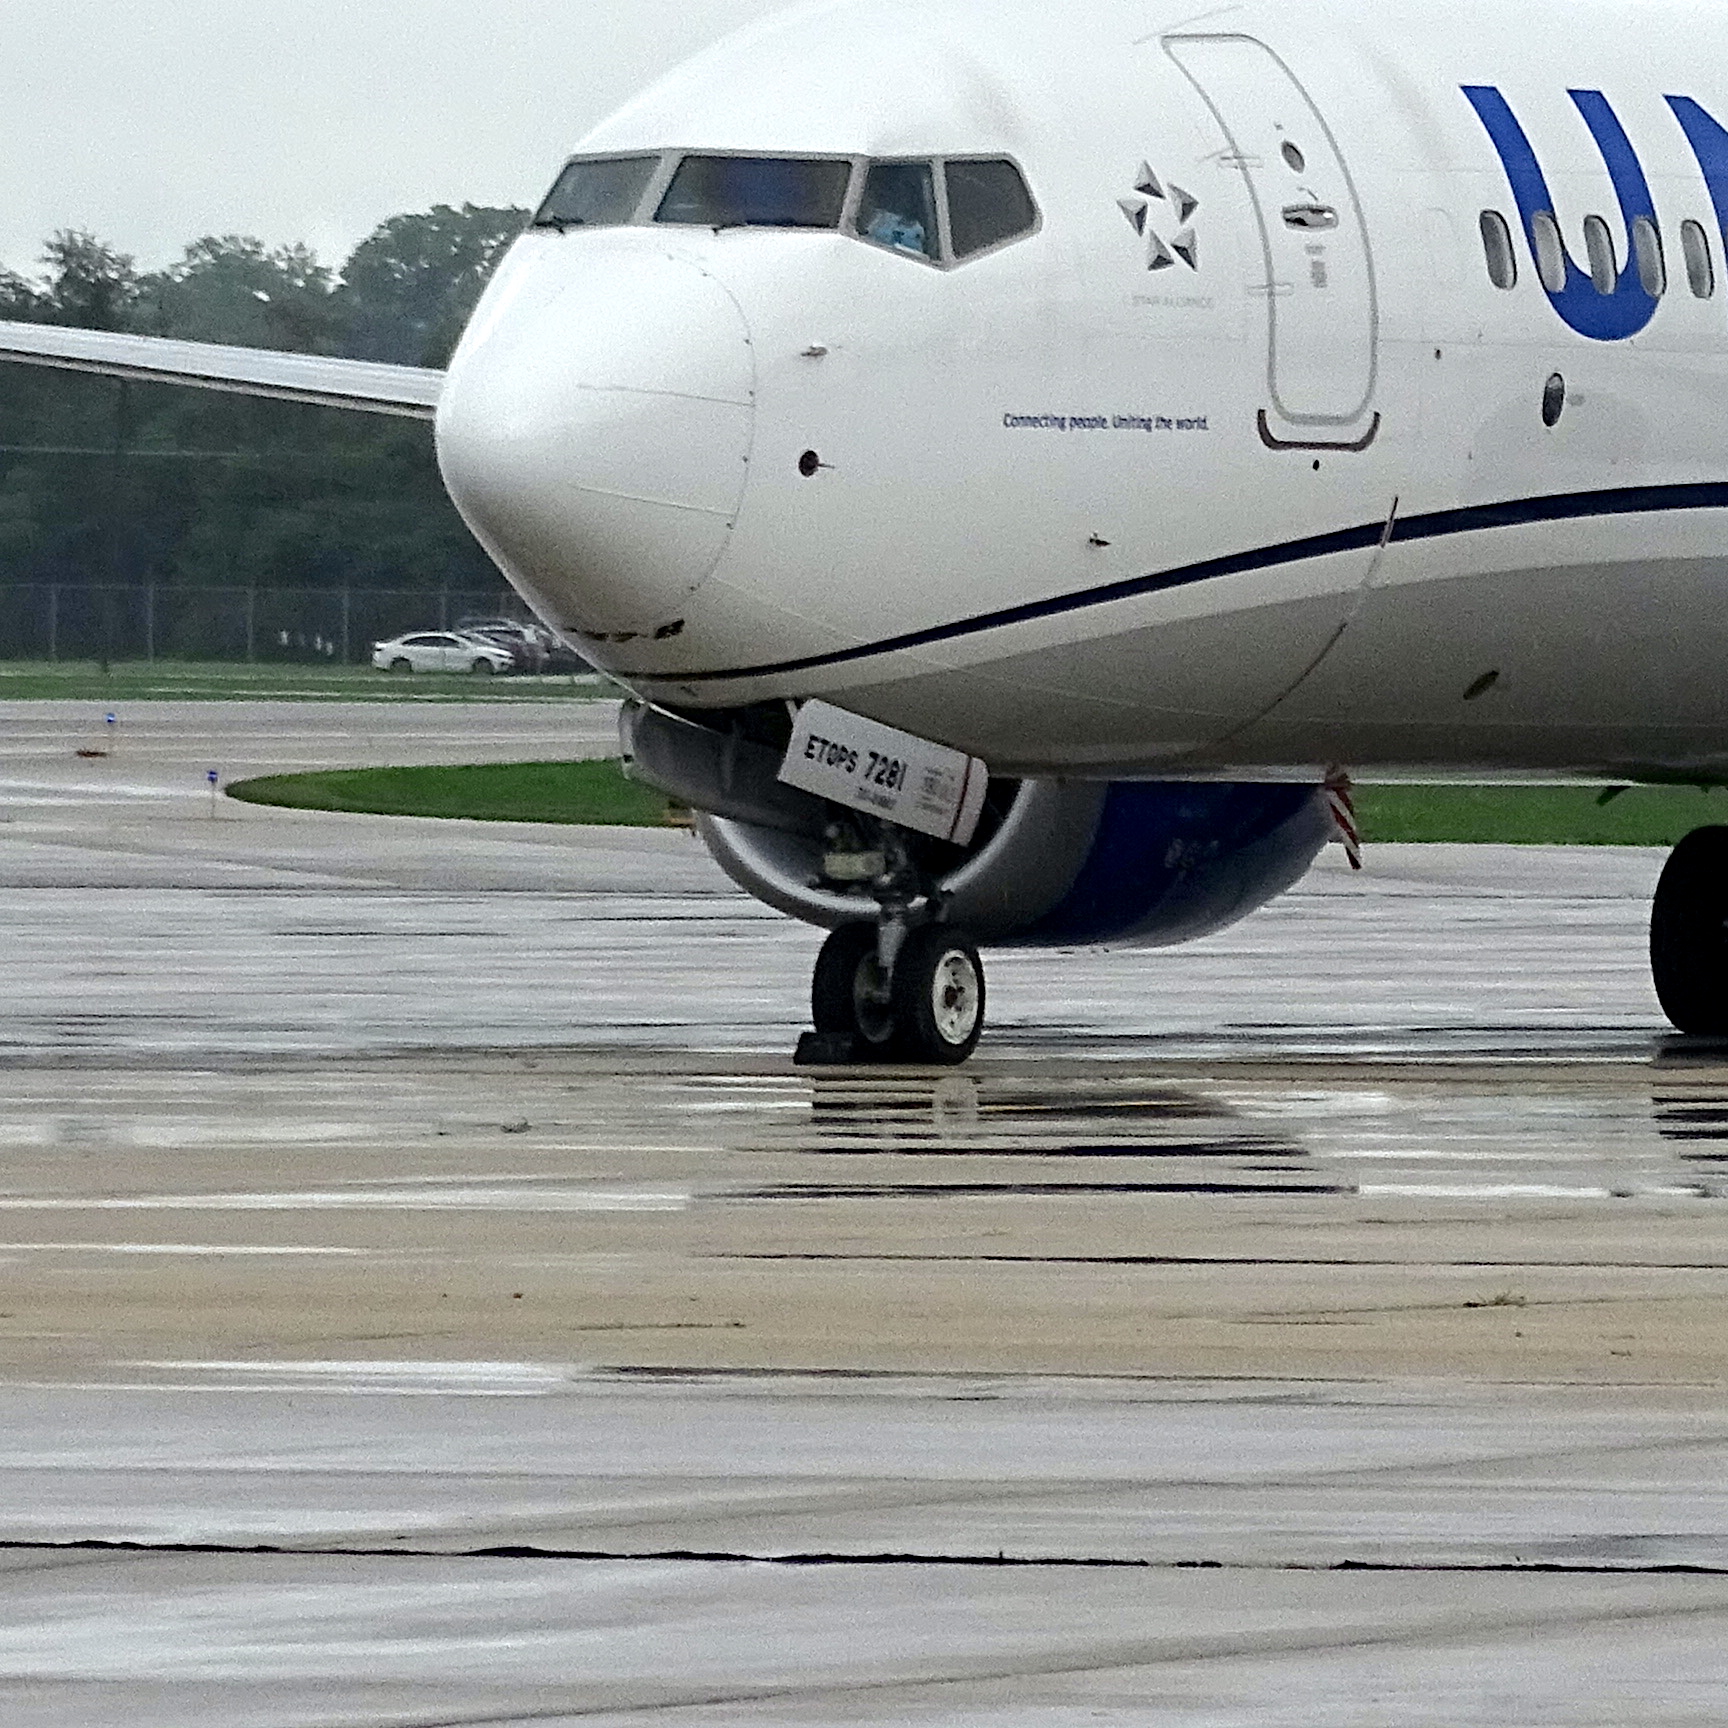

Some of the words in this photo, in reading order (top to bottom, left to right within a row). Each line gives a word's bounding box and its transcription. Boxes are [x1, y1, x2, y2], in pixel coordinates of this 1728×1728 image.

[1003, 413, 1066, 432] Connecting
[1111, 413, 1152, 432] Uniting
[1155, 415, 1174, 430] the
[804, 734, 859, 773] ETOPS
[865, 751, 909, 792] 7281
